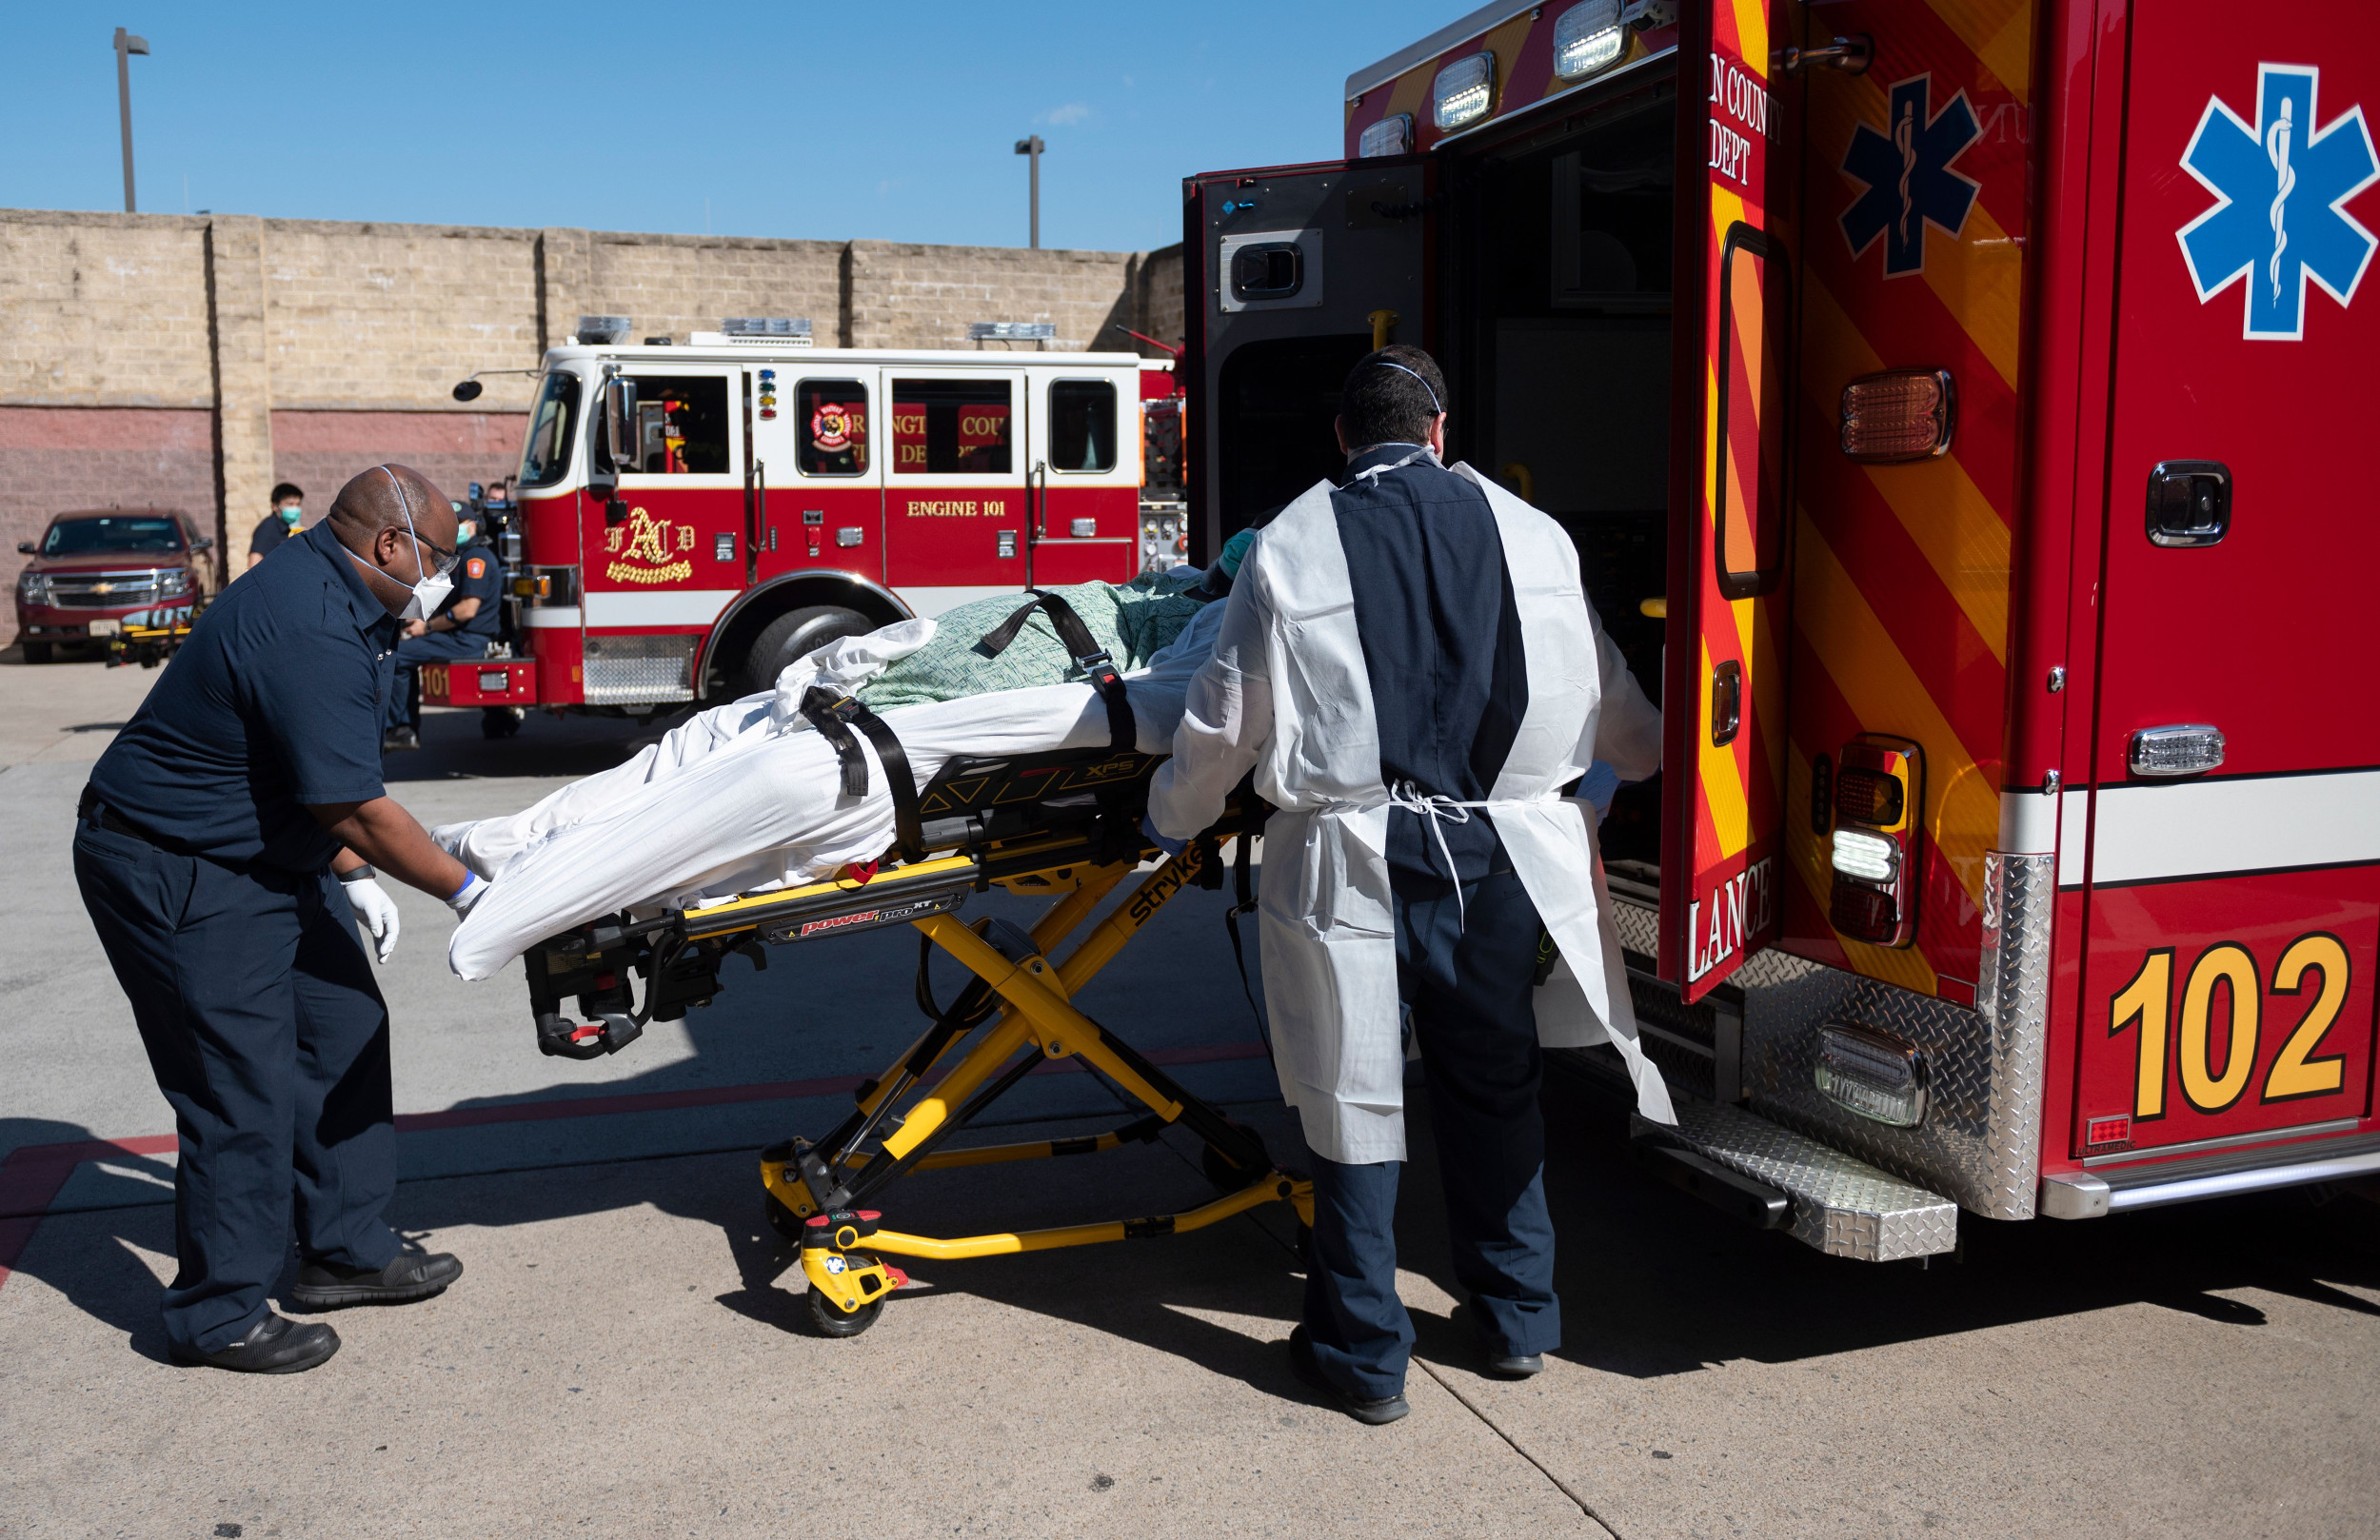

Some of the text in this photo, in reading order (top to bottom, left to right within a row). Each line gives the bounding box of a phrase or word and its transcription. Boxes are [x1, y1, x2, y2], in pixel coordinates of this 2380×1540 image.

[1708, 53, 1725, 108] N
[1708, 118, 1751, 186] DEPT
[906, 501, 1005, 517] ENGINE 101
[424, 667, 449, 697] 101
[1086, 760, 1135, 777] XPS
[1688, 857, 1772, 982] LANCE
[2107, 930, 2352, 1124] 102
[2078, 1140, 2136, 1155] ULTRAMEDIC
